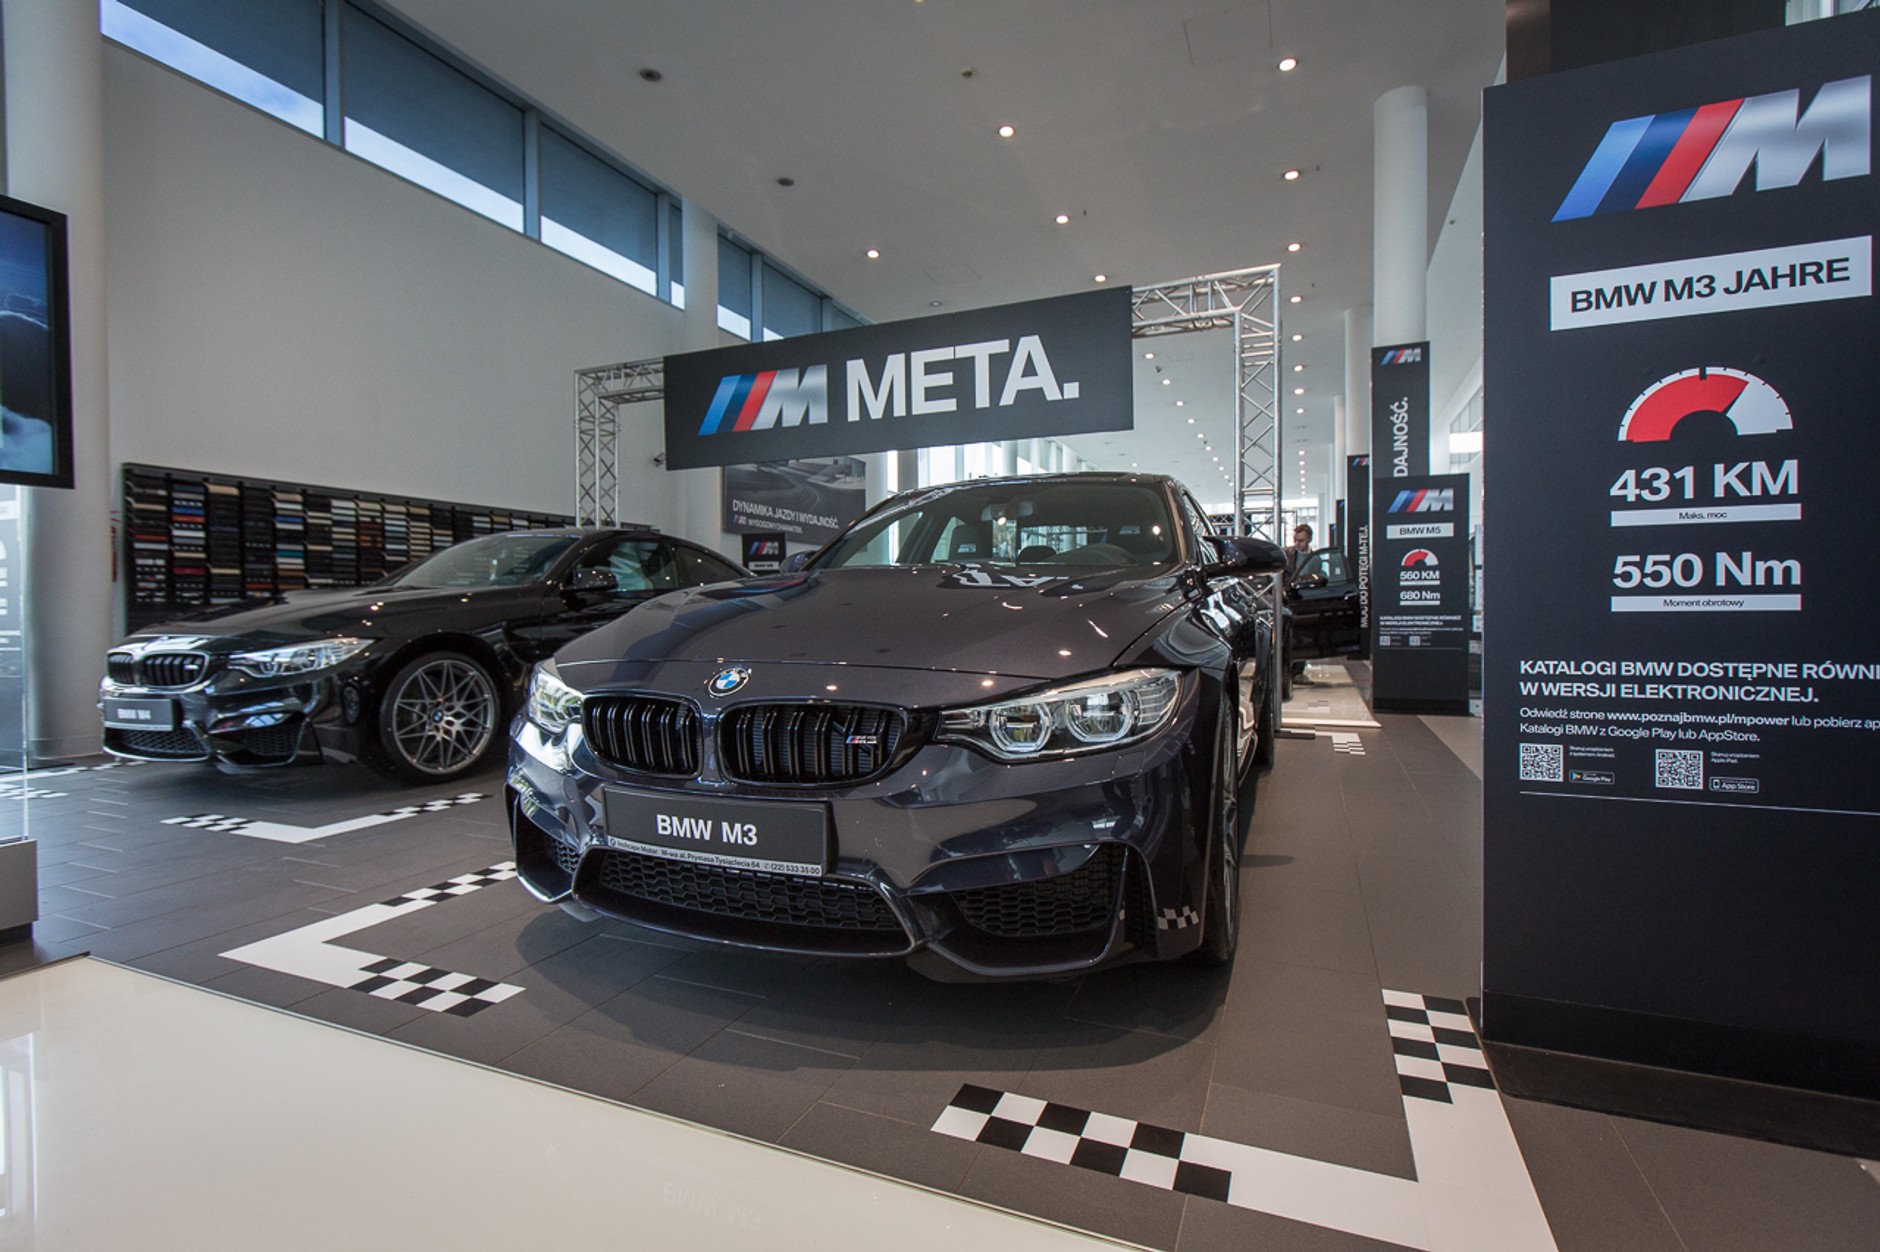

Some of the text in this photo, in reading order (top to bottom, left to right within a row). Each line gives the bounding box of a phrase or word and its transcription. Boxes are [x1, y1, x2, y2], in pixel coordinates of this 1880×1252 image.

[1570, 257, 1851, 314] BMW M3 JAHRE
[846, 334, 1080, 423] META.
[1609, 459, 1799, 502] 431 KM
[1706, 511, 1728, 519] moc
[1399, 526, 1441, 536] BMW M5
[1400, 570, 1440, 580] 560 KM
[1612, 551, 1802, 588] 550 Nm
[1359, 591, 1368, 605] DO
[1400, 590, 1441, 600] 680 Nm
[1663, 598, 1745, 608] Moment obrotowy
[1519, 660, 1617, 675] KATALOGI
[1620, 661, 1674, 677] BMW
[1677, 662, 1798, 681] DOSTĘPNE
[1519, 681, 1819, 703] W WERSJI ELEKTRONICZNEJ.
[1519, 707, 1568, 719] Odwiedź
[1606, 711, 1790, 725] www.poznajbmw.pl/mpower
[1791, 715, 1812, 726] lub
[1813, 716, 1863, 729] pobierz
[1519, 723, 1761, 742] Katalogi BMW z Google Play lub AppStore.
[656, 813, 758, 846] BMW M3
